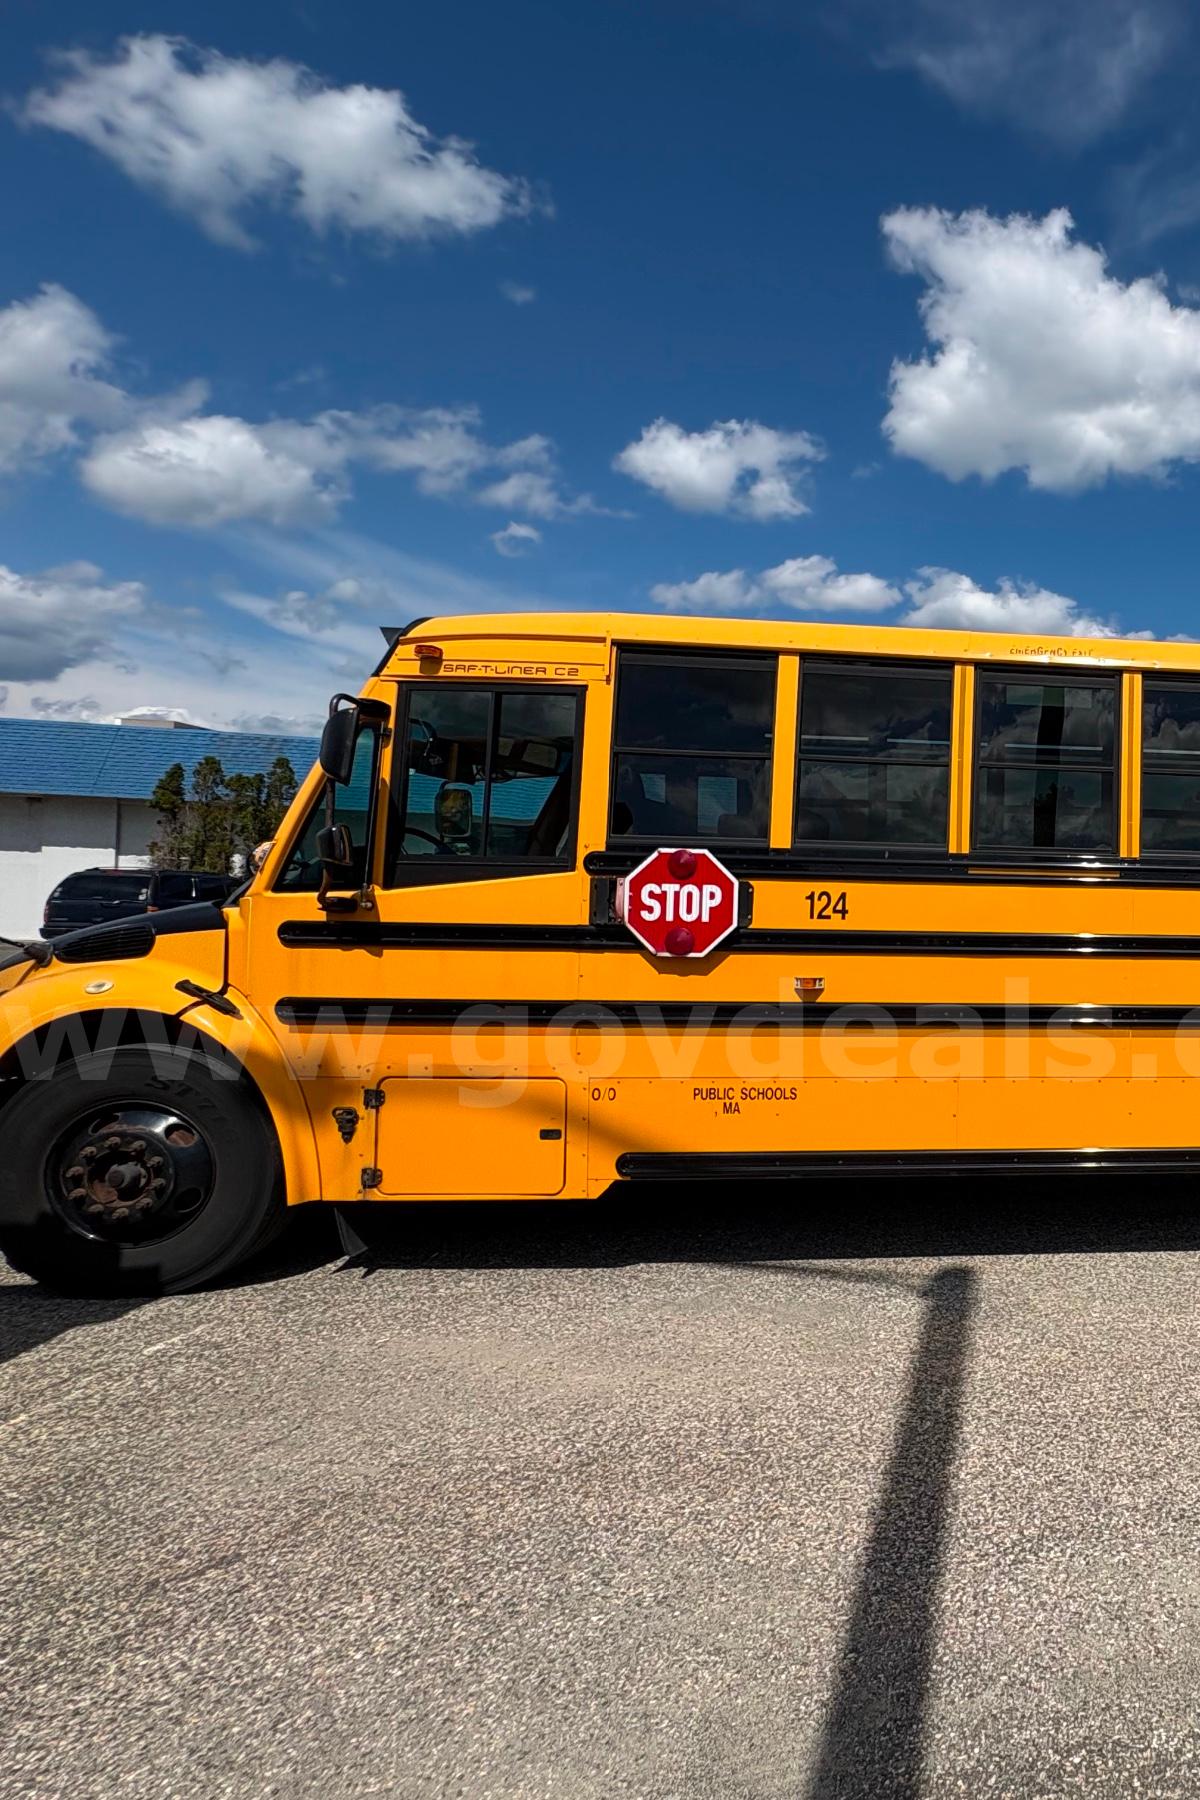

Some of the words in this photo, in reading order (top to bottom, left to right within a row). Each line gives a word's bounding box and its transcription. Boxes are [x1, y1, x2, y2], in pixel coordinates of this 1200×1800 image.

[554, 667, 580, 677] C2
[640, 883, 722, 922] STOP
[805, 891, 848, 920] 124
[693, 1087, 735, 1100] PUBLIC
[740, 1087, 798, 1100] SCHOOLS
[723, 1102, 741, 1114] MA
